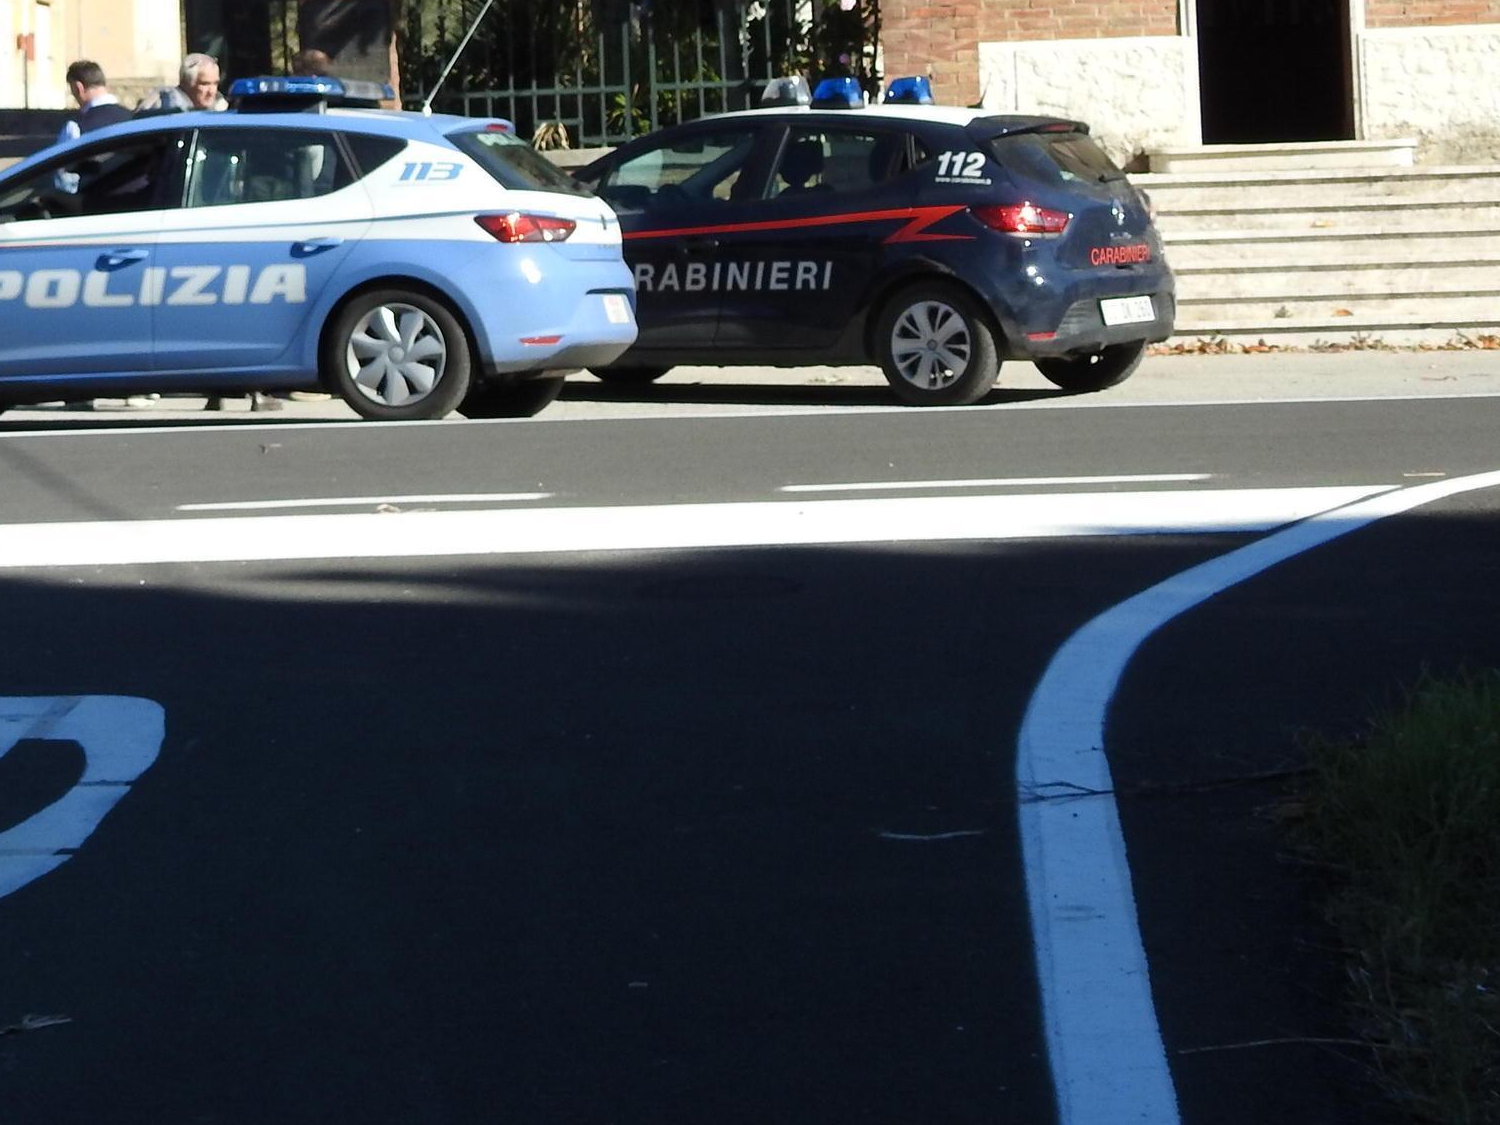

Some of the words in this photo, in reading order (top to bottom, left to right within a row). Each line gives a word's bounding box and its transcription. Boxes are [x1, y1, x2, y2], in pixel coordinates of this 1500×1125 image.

[398, 162, 464, 181] 113
[938, 151, 986, 177] 112
[1090, 244, 1151, 266] CARABINIERI
[634, 261, 834, 292] RABINIERI
